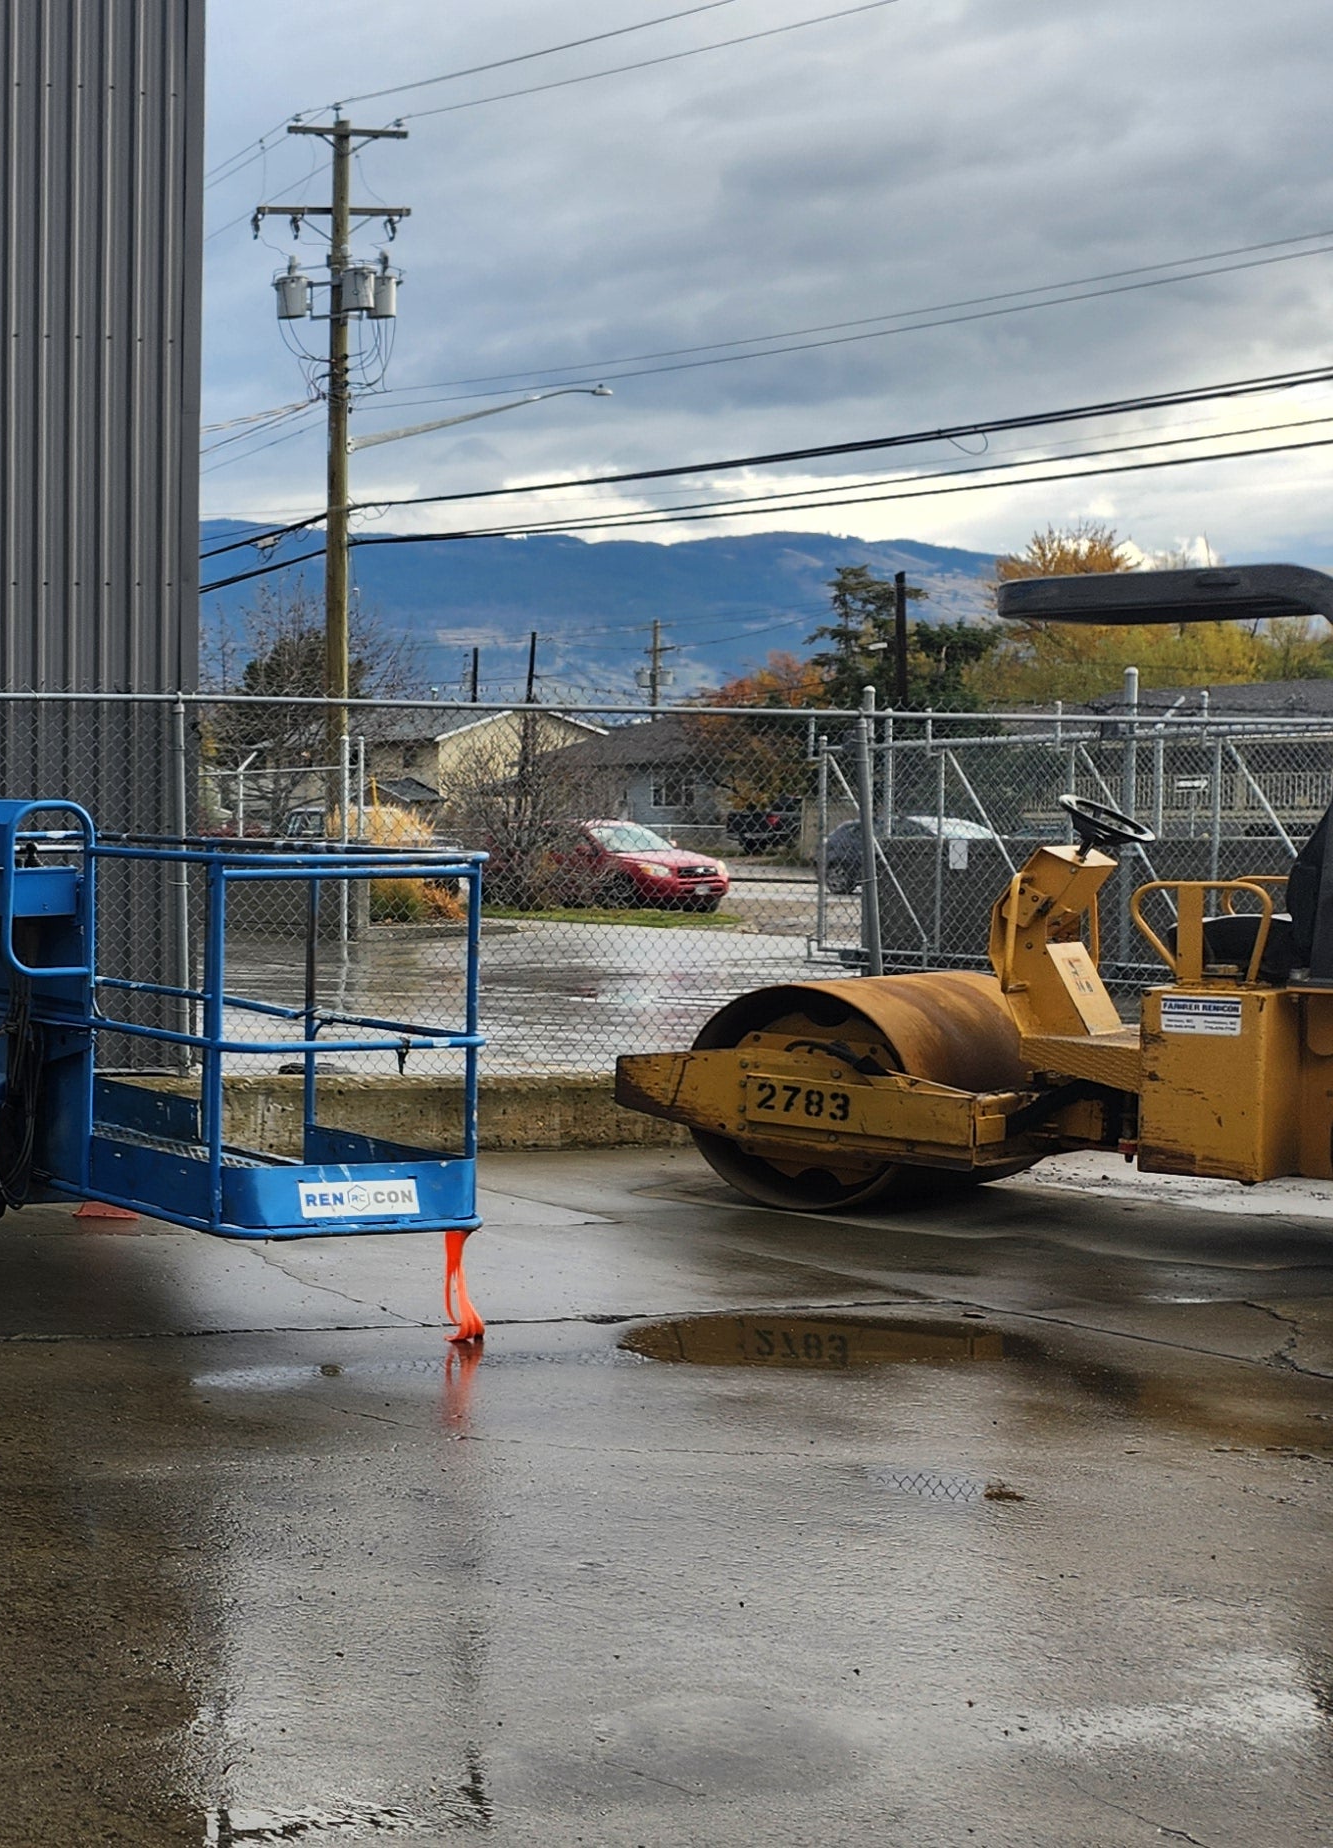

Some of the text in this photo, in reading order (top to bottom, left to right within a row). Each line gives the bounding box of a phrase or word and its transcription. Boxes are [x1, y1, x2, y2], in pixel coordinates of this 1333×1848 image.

[756, 1083, 850, 1121] 2783
[304, 1192, 345, 1207] REN
[373, 1190, 414, 1204] CON
